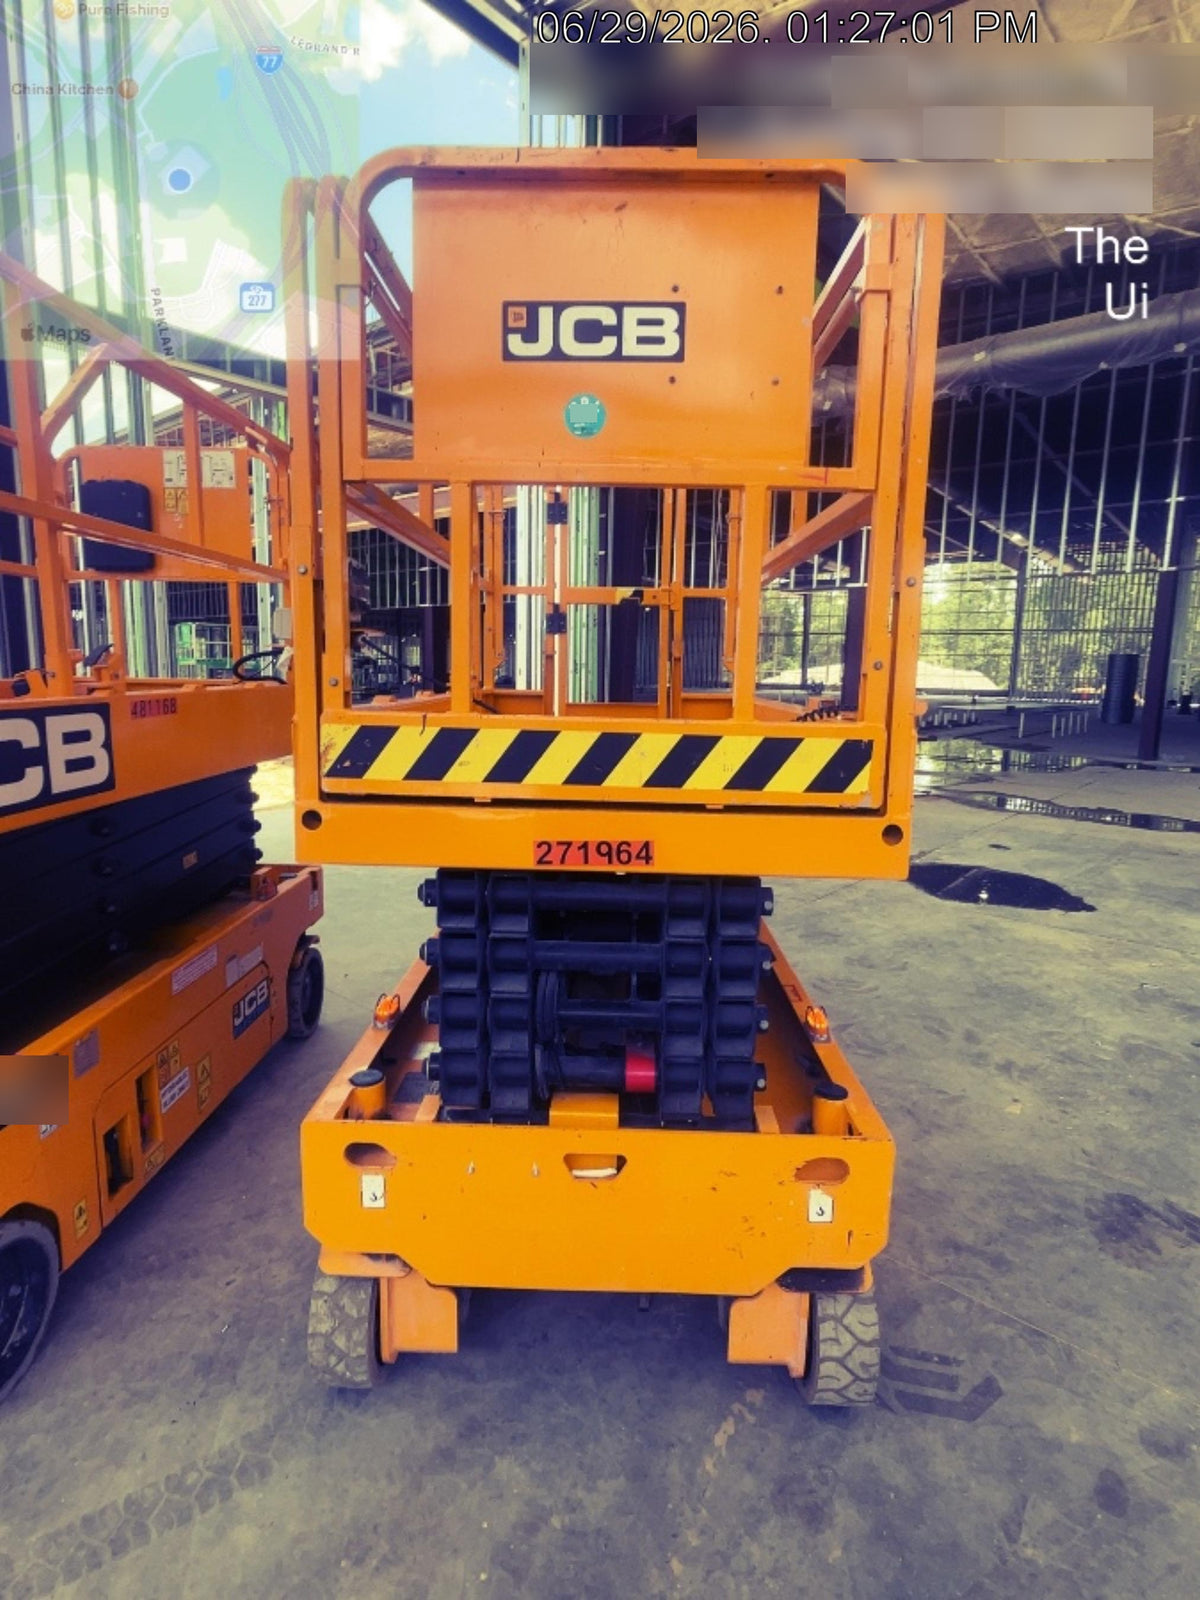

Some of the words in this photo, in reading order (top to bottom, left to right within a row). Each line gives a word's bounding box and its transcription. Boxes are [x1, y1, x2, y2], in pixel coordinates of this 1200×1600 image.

[507, 304, 681, 357] JCB
[536, 840, 654, 865] 271964
[233, 978, 269, 1027] JCB
